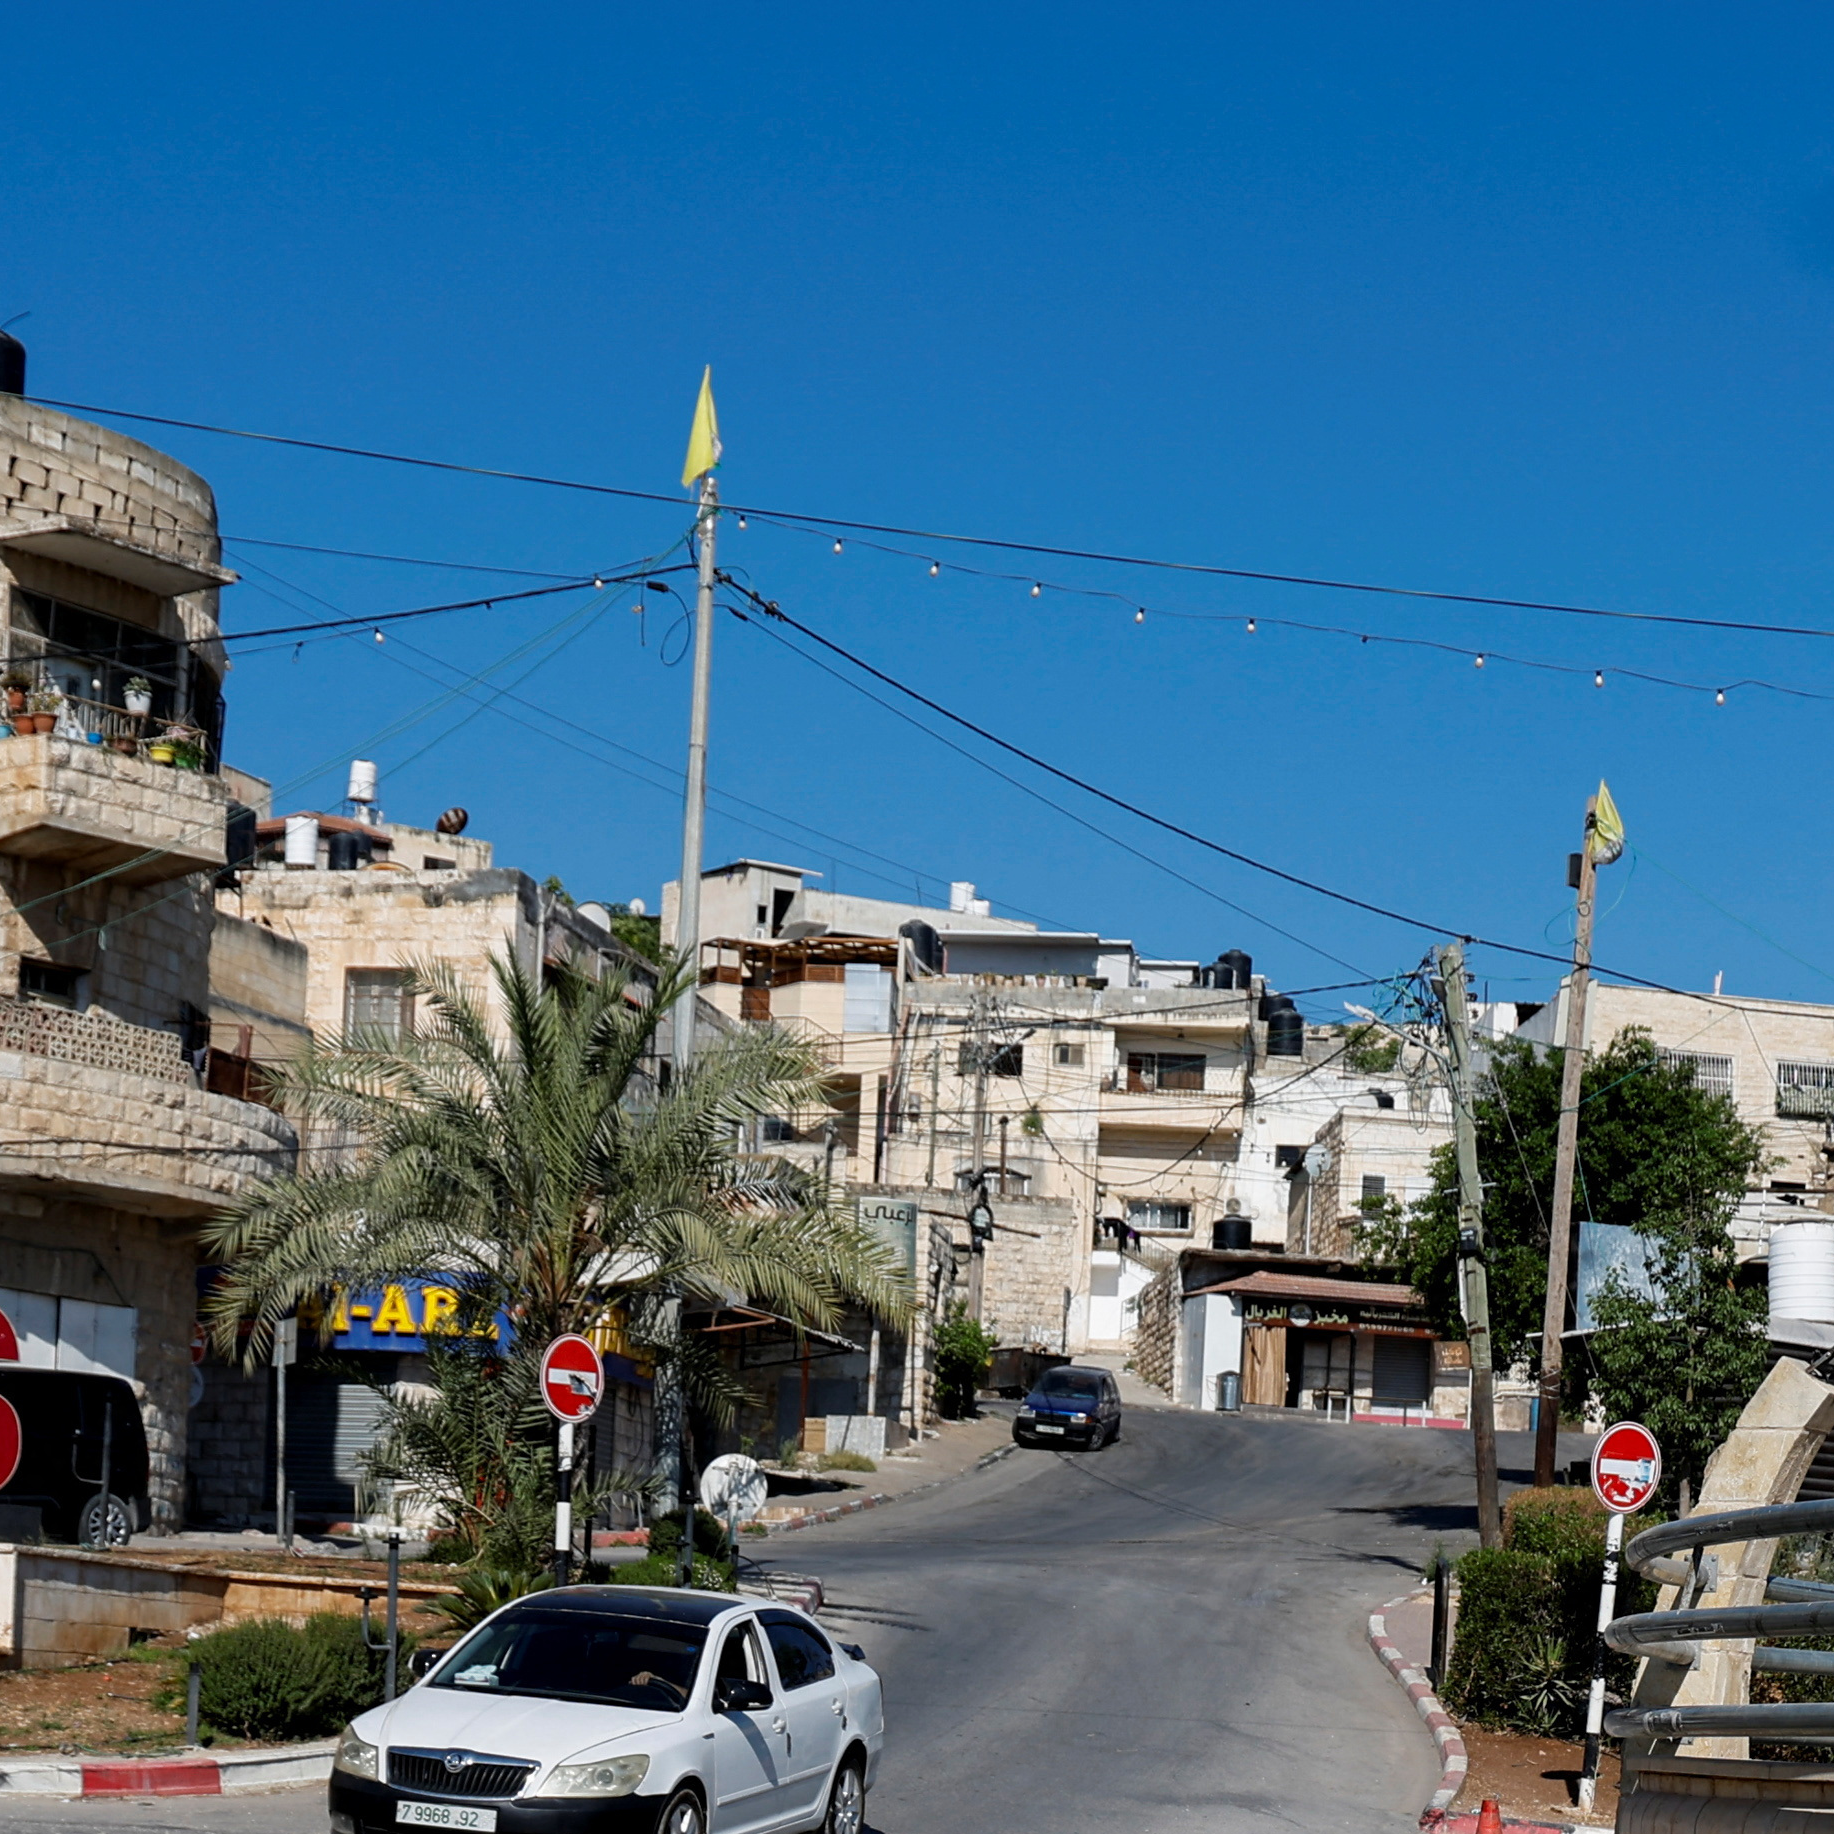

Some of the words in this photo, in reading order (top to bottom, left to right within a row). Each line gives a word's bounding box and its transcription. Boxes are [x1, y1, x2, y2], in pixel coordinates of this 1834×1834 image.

[1244, 1304, 1288, 1320] الغربال
[1313, 1308, 1349, 1326] مخبز
[401, 1804, 413, 1820] 7
[414, 1805, 451, 1824] 9968
